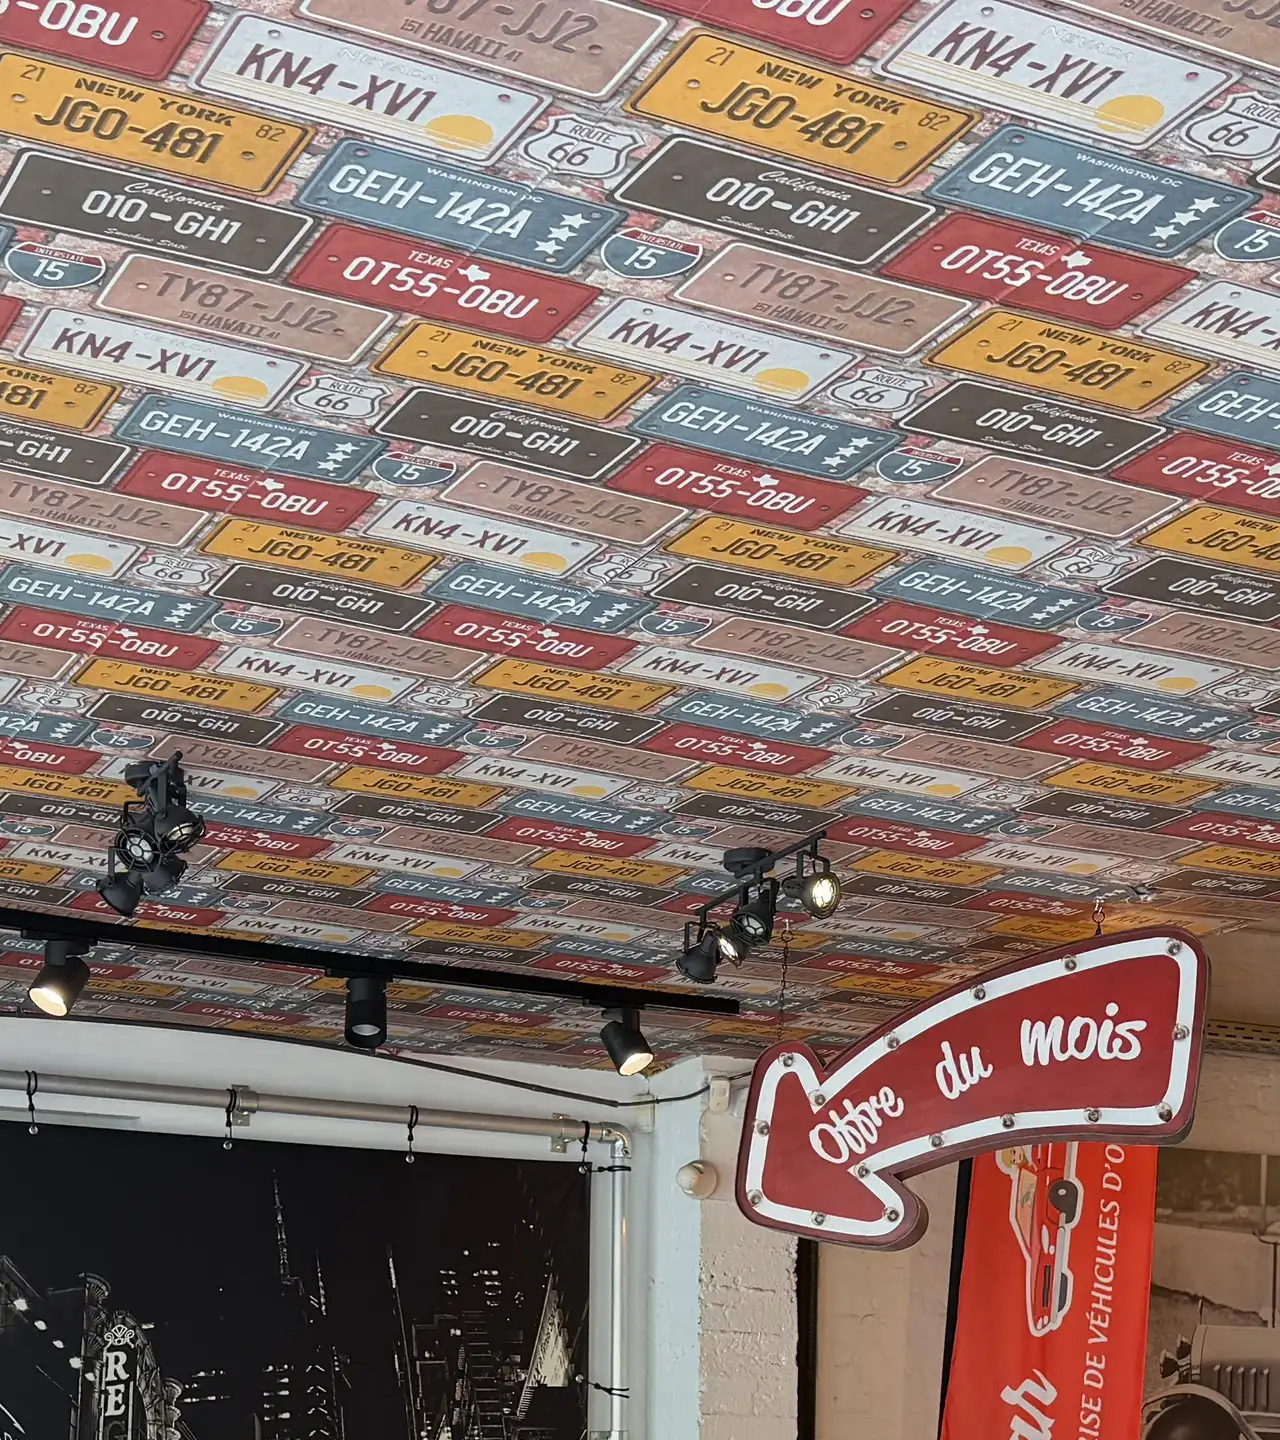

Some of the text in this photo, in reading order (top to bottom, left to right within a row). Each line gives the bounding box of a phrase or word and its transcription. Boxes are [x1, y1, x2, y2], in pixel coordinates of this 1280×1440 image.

[705, 47, 736, 66] 21
[74, 75, 237, 128] NEW YORK
[756, 62, 907, 115] NEW YORK
[564, 121, 624, 144] ROUTE
[917, 111, 951, 131] 82
[1195, 122, 1259, 146] 66
[538, 143, 595, 166] 66
[117, 183, 226, 212] California
[747, 171, 852, 201] California
[968, 152, 1166, 224] GEH-142A
[329, 166, 532, 237] GEH-142A
[408, 251, 455, 269] TEXAS
[624, 246, 674, 269] 15
[1015, 238, 1062, 256] TEXAS
[33, 258, 76, 281] 15
[157, 273, 340, 334] TY87-JJ2
[740, 263, 916, 325] TY87-JJ2
[197, 314, 270, 338] HAWAII
[140, 411, 310, 460] GEH-142A
[660, 404, 826, 454] GEH-142A
[897, 573, 1036, 610] GEH-142A
[293, 703, 418, 732] GEH-142A
[936, 1041, 994, 1100] du
[1020, 1002, 1148, 1067] mois
[1089, 1198, 1123, 1343] VÉHICULES
[1082, 1353, 1106, 1386] DE
